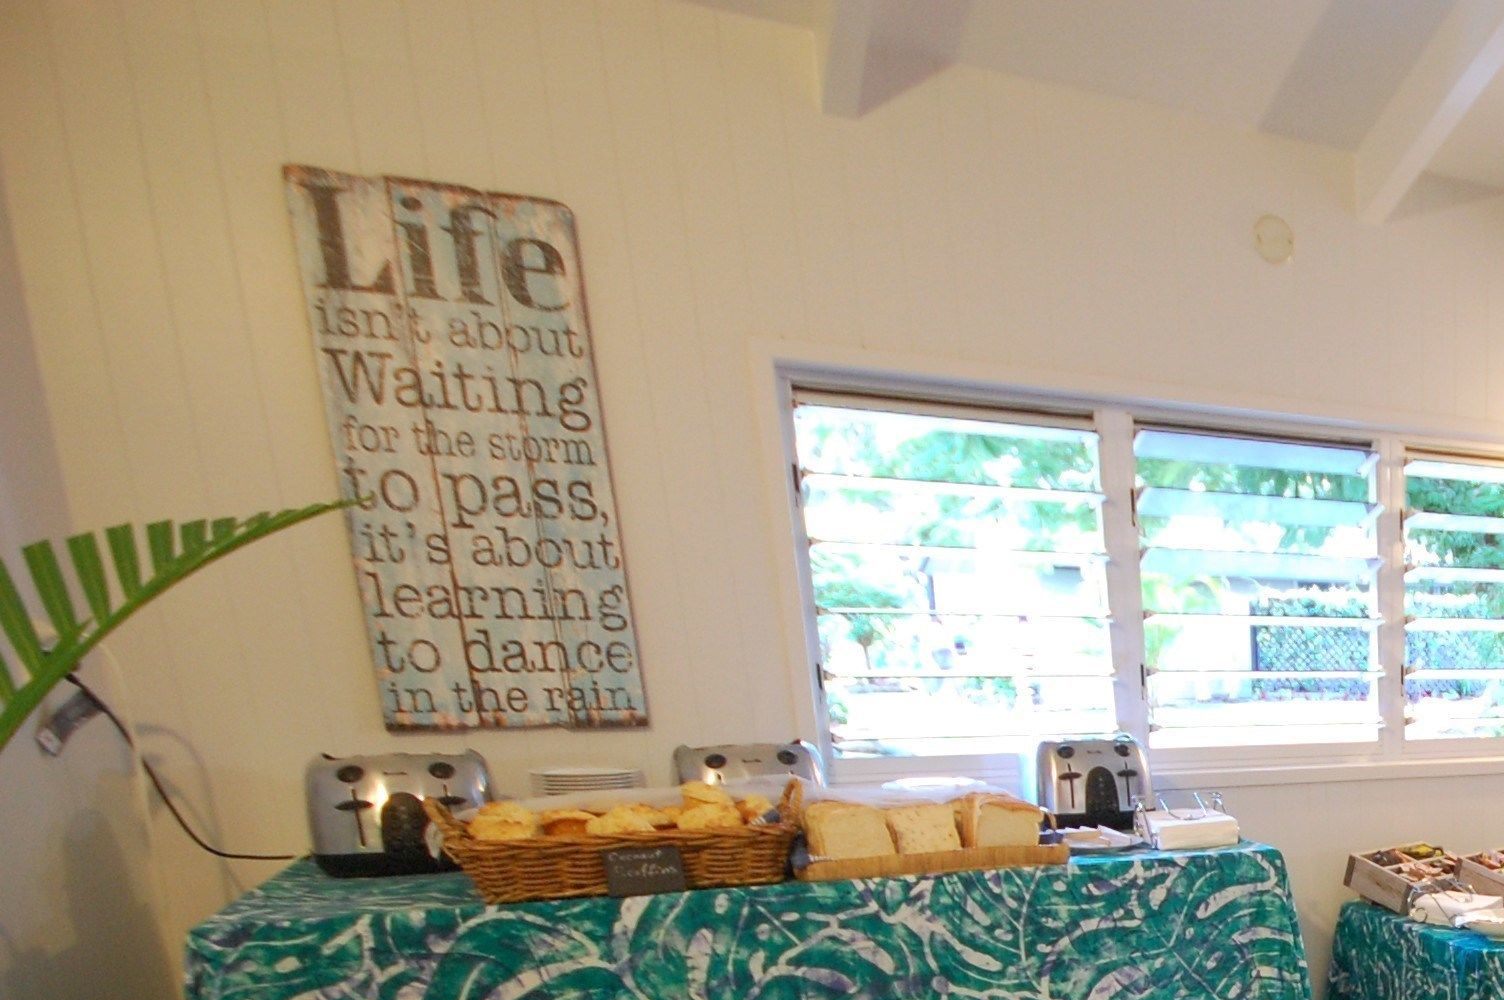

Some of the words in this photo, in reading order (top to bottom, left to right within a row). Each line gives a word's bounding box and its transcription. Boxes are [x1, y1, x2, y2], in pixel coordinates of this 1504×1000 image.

[301, 184, 570, 312] Life
[314, 298, 433, 345] isn't
[448, 311, 585, 359] about
[320, 347, 593, 433] Waiting
[342, 414, 401, 453] for
[411, 419, 476, 458] the
[488, 427, 598, 467] storm
[343, 455, 420, 513] to
[441, 471, 610, 529] pass,
[360, 521, 452, 565] it's
[471, 525, 621, 570] about
[365, 570, 628, 633] learning
[376, 629, 442, 674] to
[464, 628, 634, 674] dance
[386, 681, 439, 714] in
[451, 679, 530, 714] the
[541, 679, 638, 713] rain
